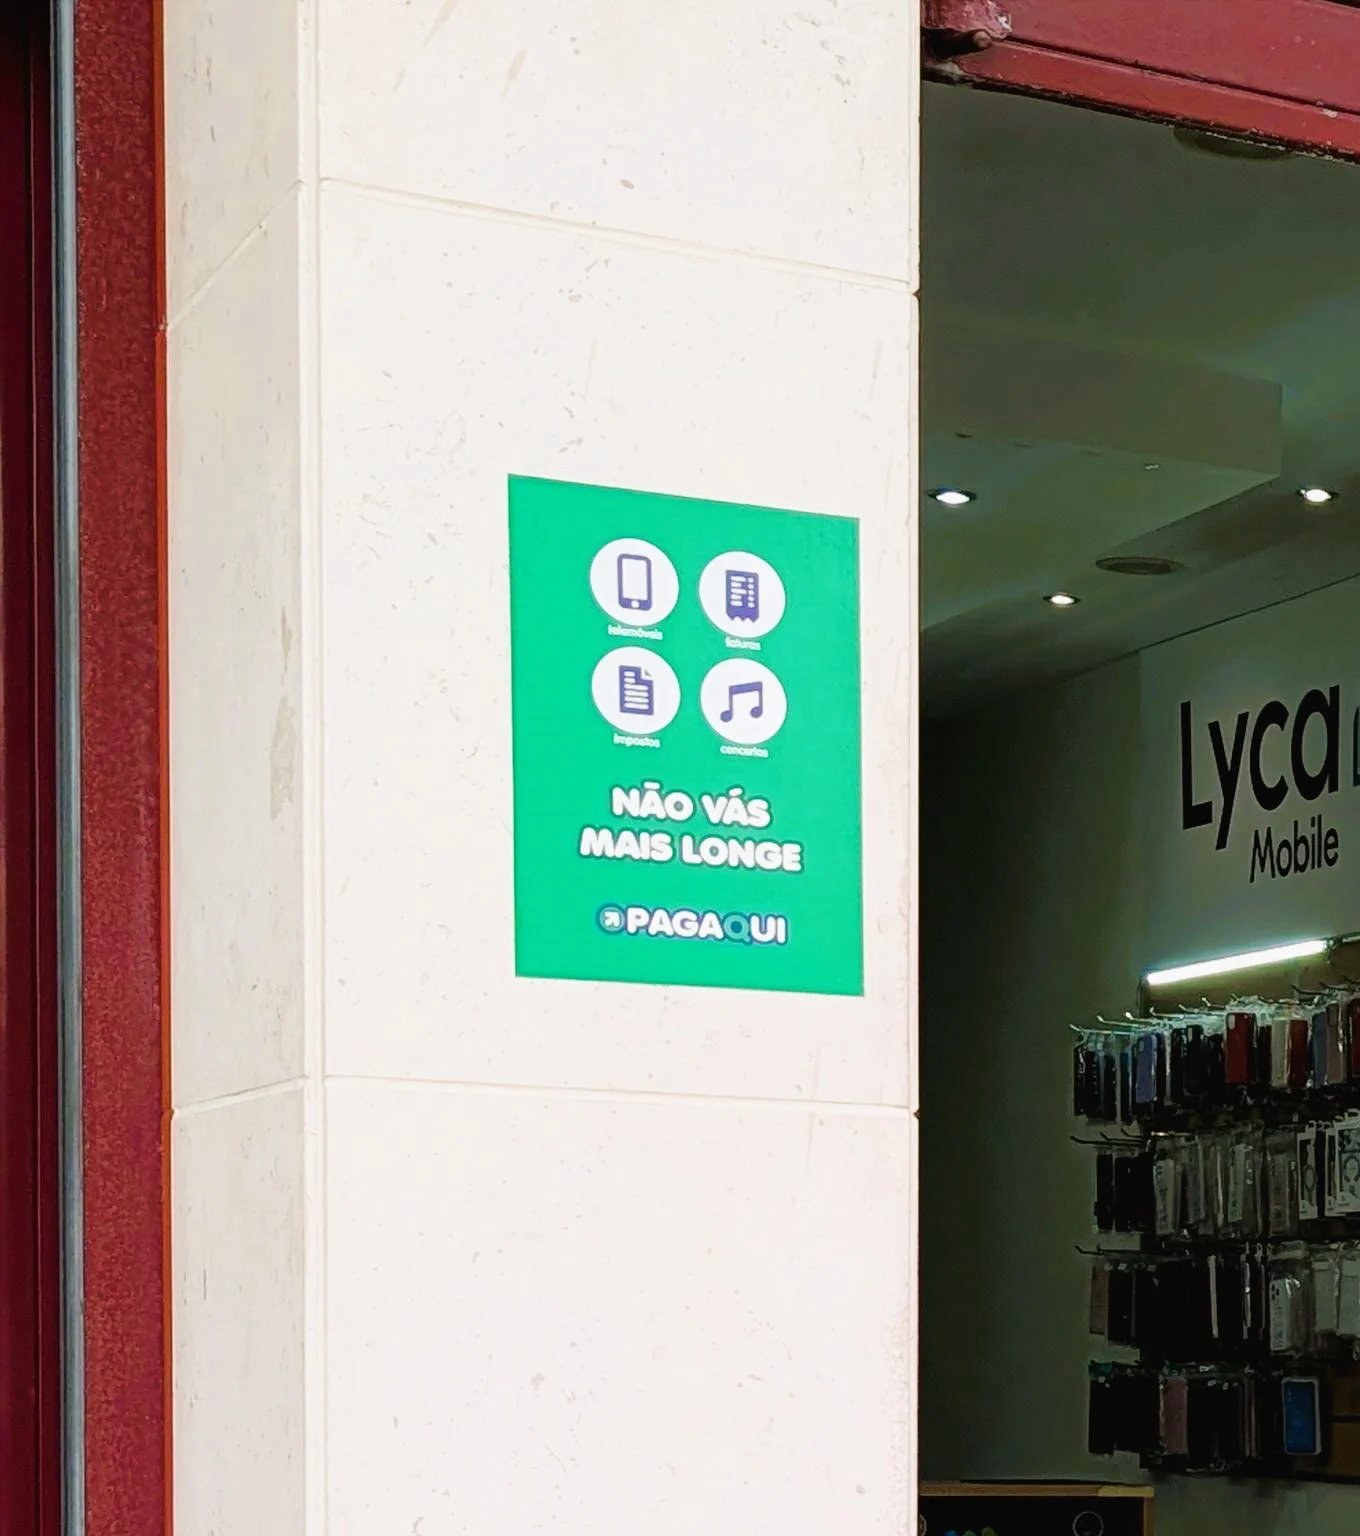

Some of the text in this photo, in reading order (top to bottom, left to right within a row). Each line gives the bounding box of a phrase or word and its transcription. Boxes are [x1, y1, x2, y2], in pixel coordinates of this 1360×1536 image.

[613, 734, 660, 748] impostos
[1180, 684, 1340, 850] Lyca
[611, 782, 771, 828] NÃO VÁS
[579, 828, 802, 872] MAIS LONGE
[1250, 814, 1339, 883] Mobile
[626, 908, 788, 944] PAGAQUI
